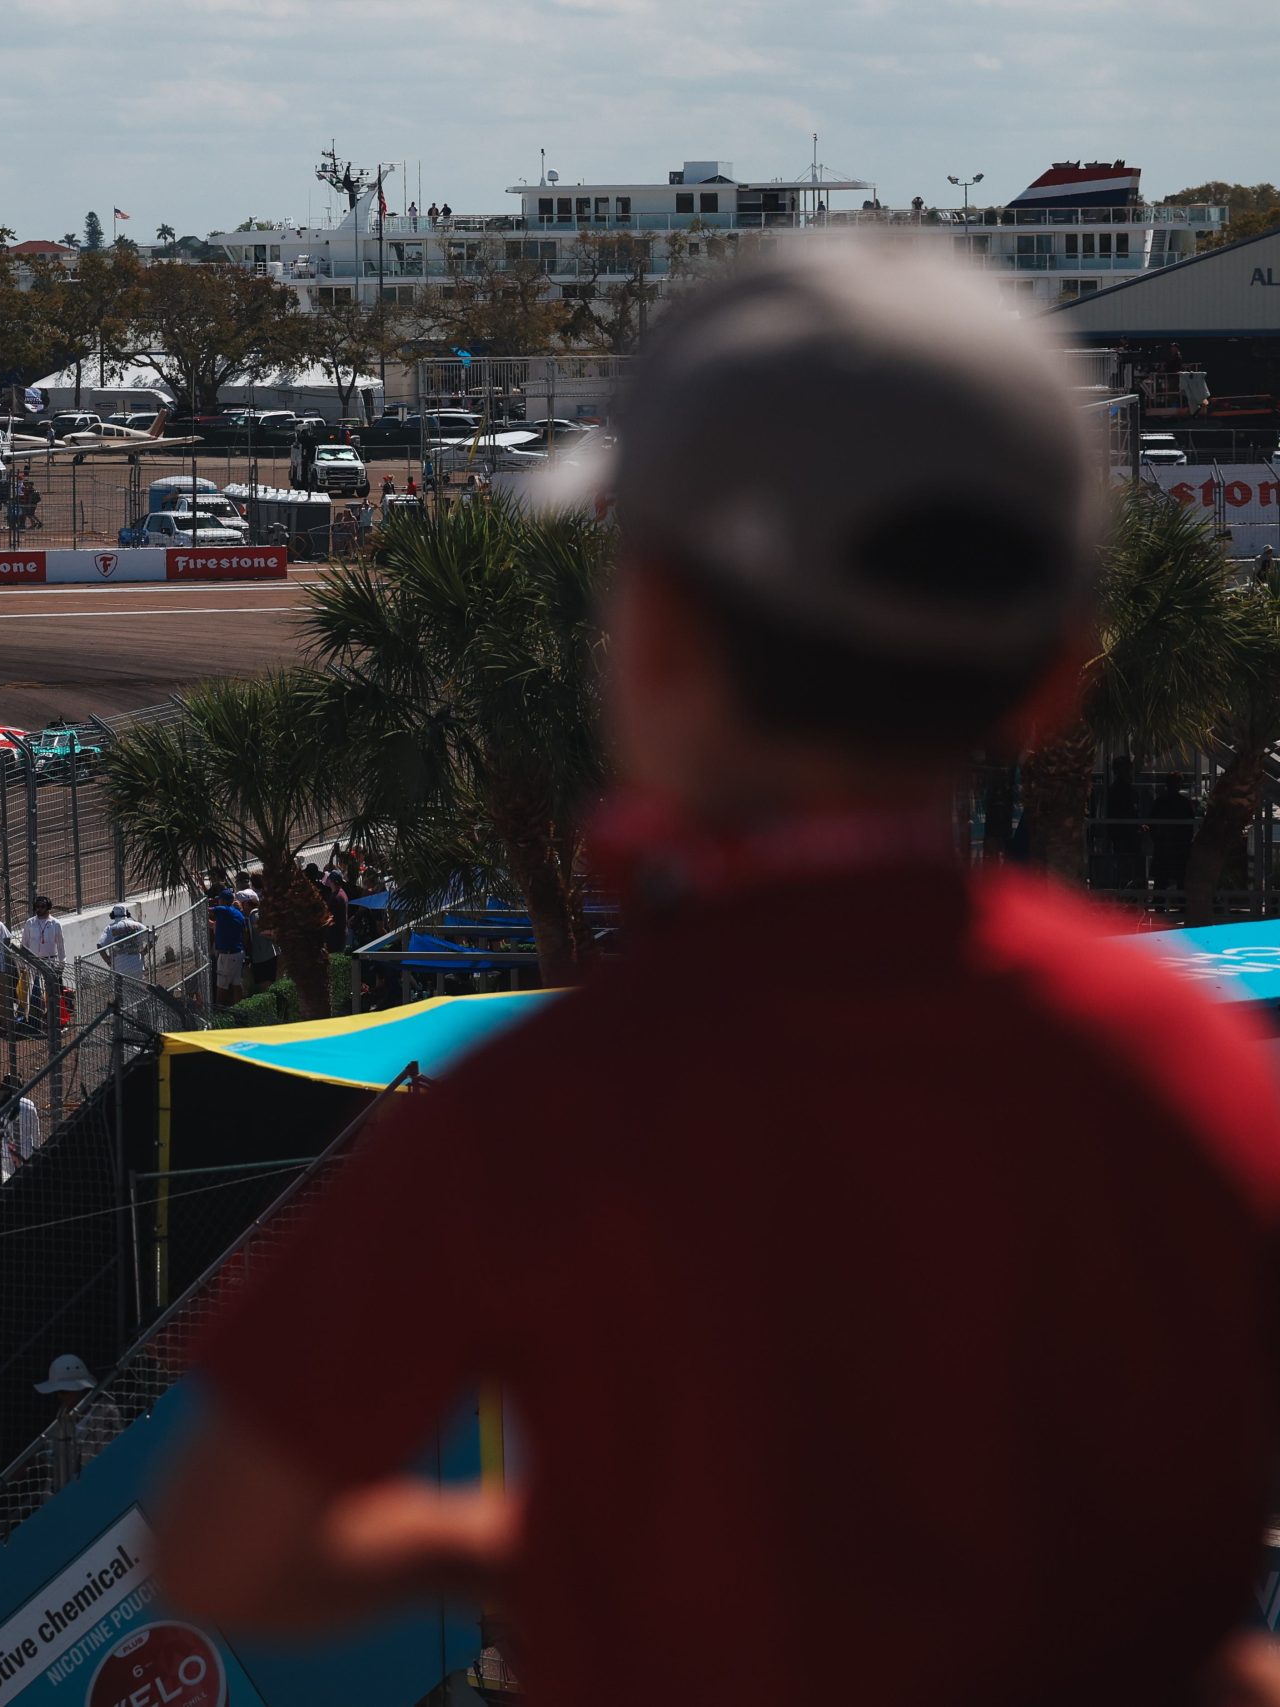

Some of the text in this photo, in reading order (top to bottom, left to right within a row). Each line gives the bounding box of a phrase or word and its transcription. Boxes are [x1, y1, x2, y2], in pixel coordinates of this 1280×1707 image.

[175, 555, 278, 572] Firestone
[37, 1544, 141, 1645] chemical.
[121, 1636, 144, 1654] PLUS
[45, 1624, 114, 1687] NICOTINE
[132, 1664, 144, 1678] 6
